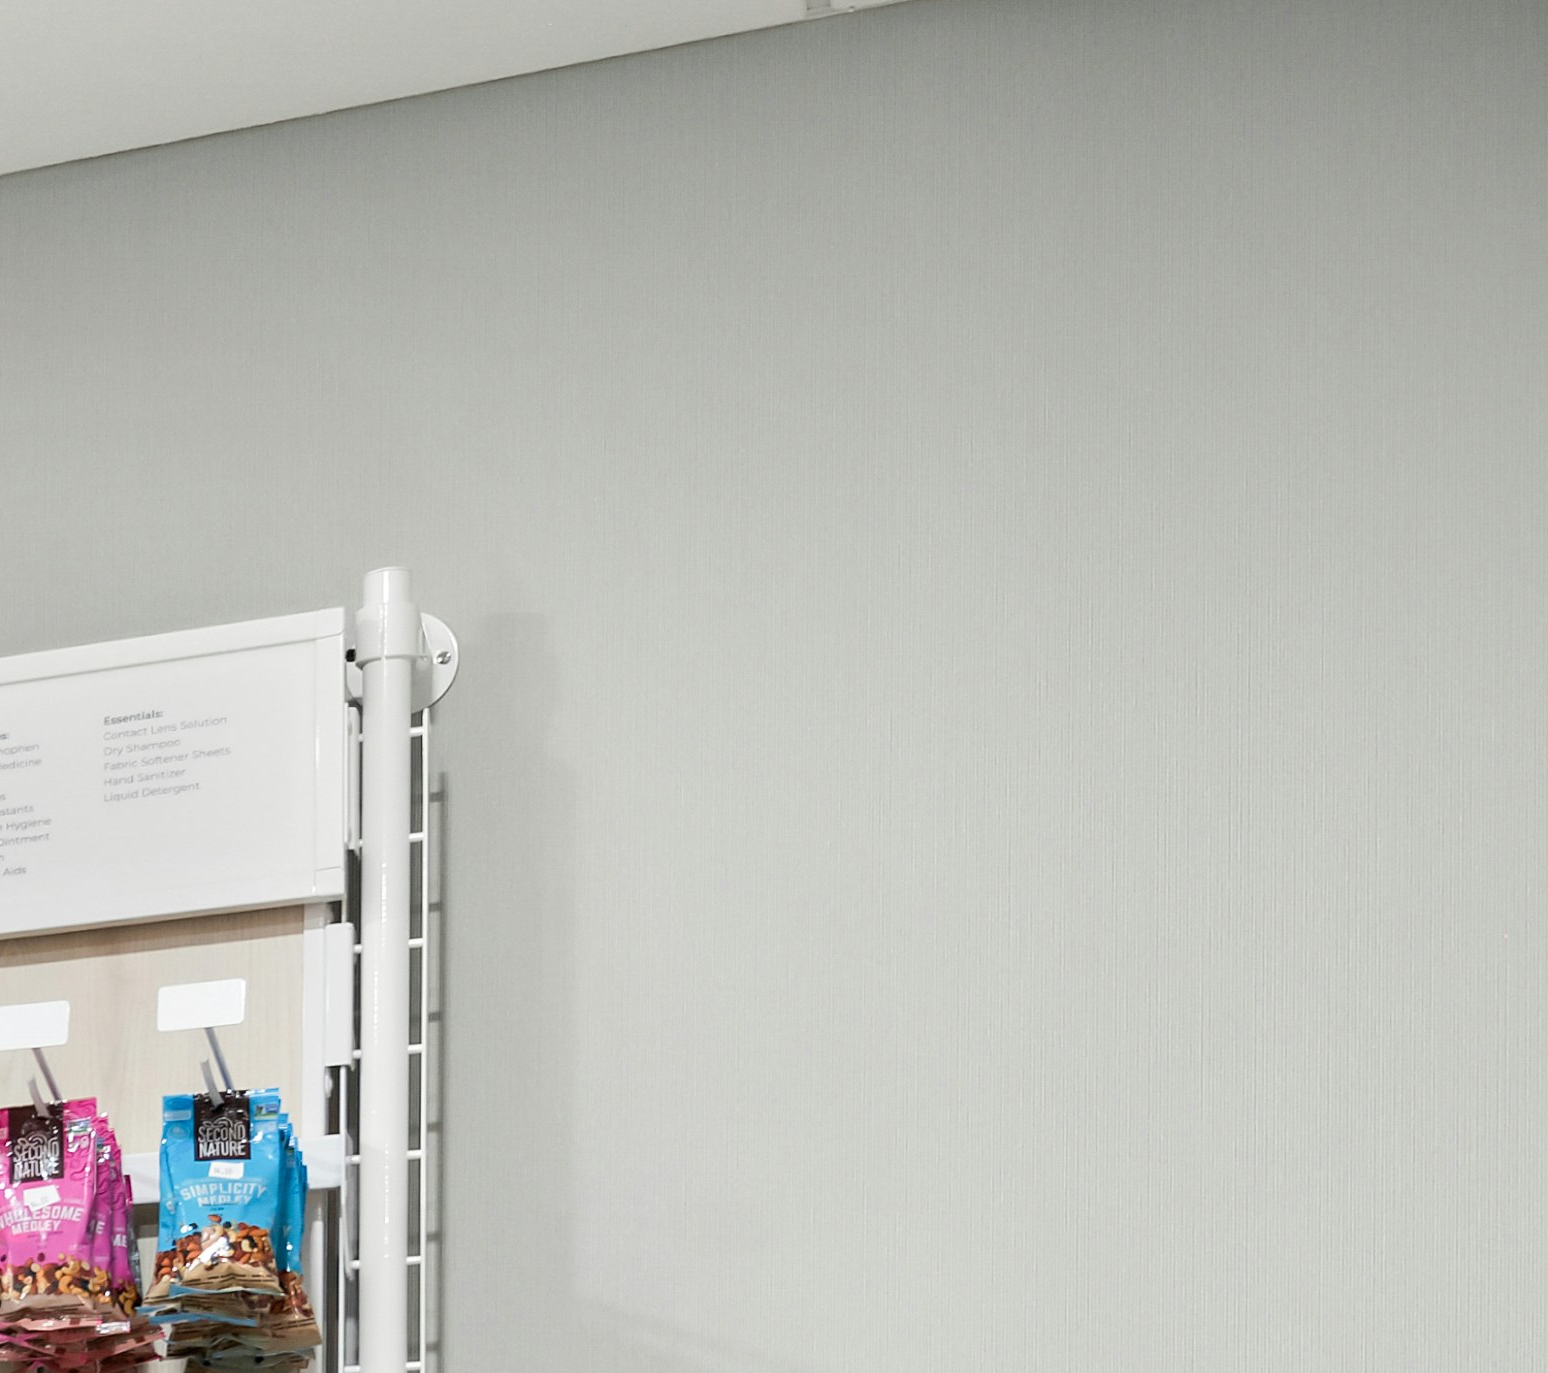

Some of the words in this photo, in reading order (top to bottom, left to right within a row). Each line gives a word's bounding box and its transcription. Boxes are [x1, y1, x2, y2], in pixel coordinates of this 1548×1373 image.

[104, 710, 163, 726] Essentials:
[104, 728, 147, 741] Contact
[151, 724, 177, 735] Lens
[180, 717, 227, 730] Solution
[104, 747, 124, 757] Dry
[126, 739, 181, 753] Shampoo
[104, 760, 137, 772] Fabric
[141, 753, 188, 767] Softener
[104, 775, 134, 786] Hand
[137, 769, 186, 782] Sanitizer
[104, 788, 138, 802] Liquid
[142, 782, 200, 798] Detergent
[6, 818, 52, 831] Hygiene
[3, 866, 27, 876] Aids
[198, 1125, 246, 1144] SECOND
[199, 1142, 247, 1158] NATURE
[180, 1182, 267, 1198] SIMPLICITY
[11, 1220, 61, 1233] MEDLEY
